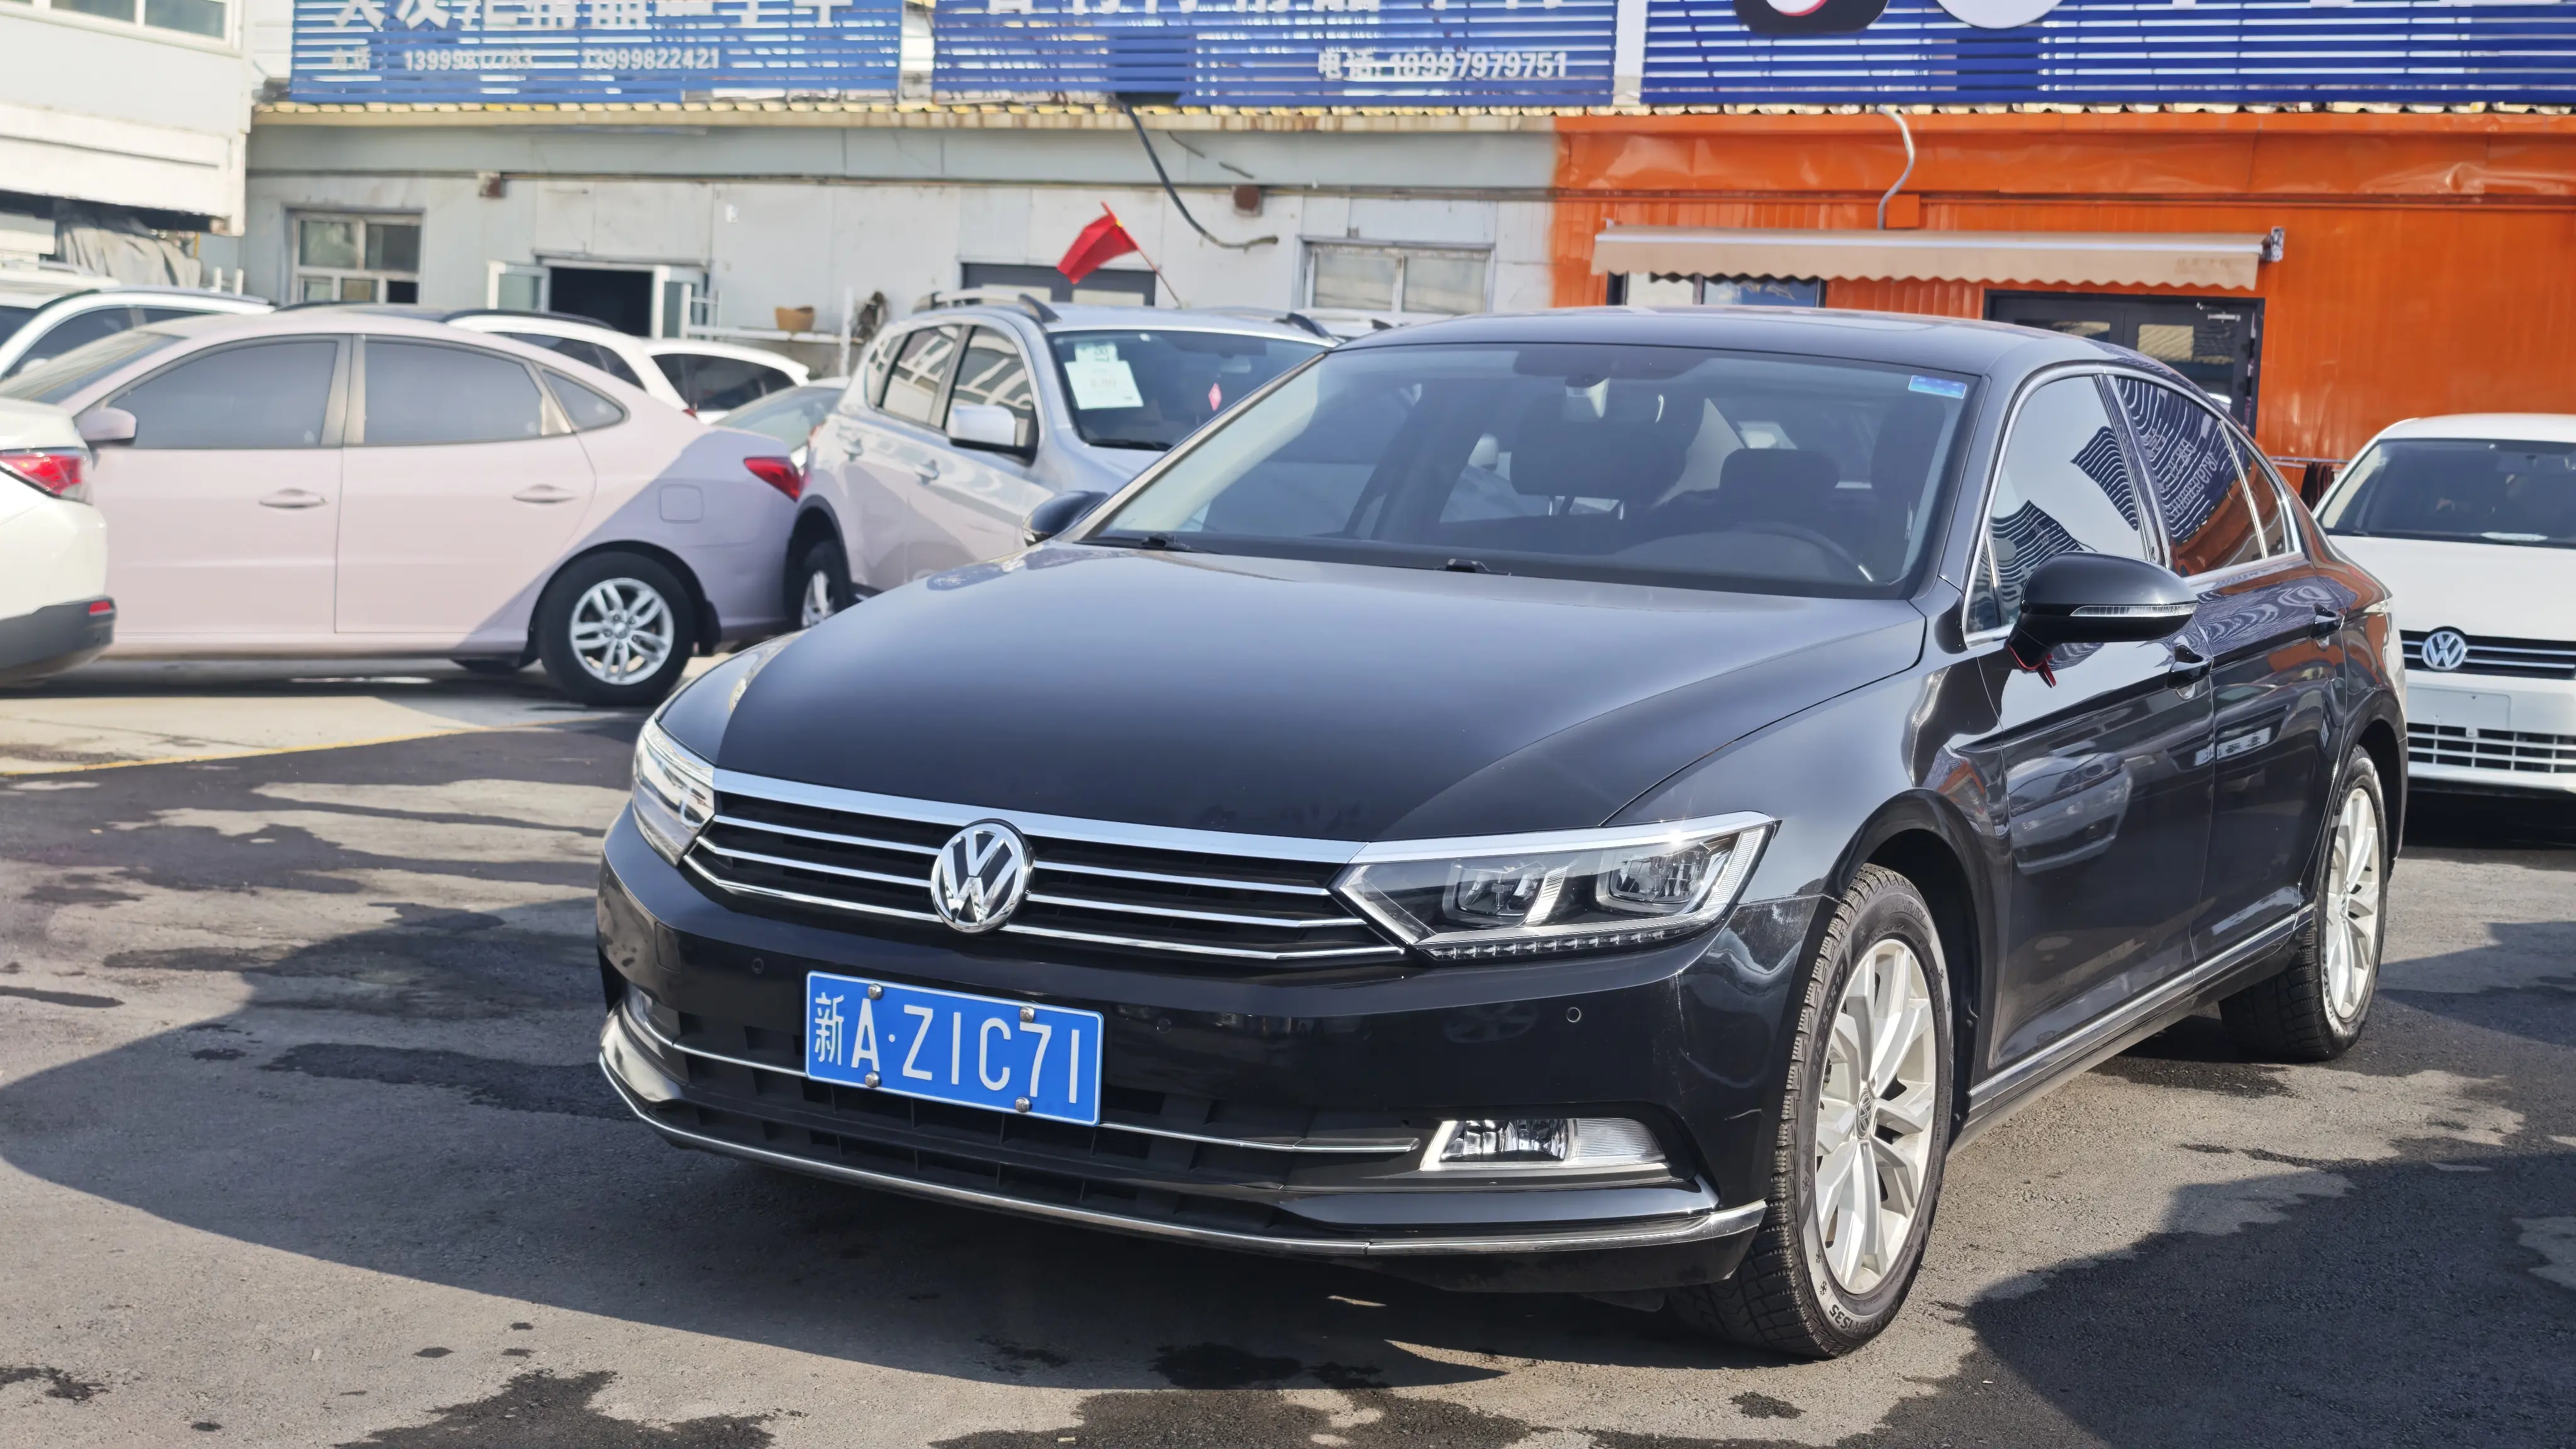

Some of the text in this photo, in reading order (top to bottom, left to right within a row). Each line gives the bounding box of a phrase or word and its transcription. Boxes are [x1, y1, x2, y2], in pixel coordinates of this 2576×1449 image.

[582, 47, 719, 69] 13999822421
[1389, 52, 1567, 79] 18997979751
[935, 824, 1024, 929] VW
[814, 992, 1080, 1104] 新A·Z1C71
